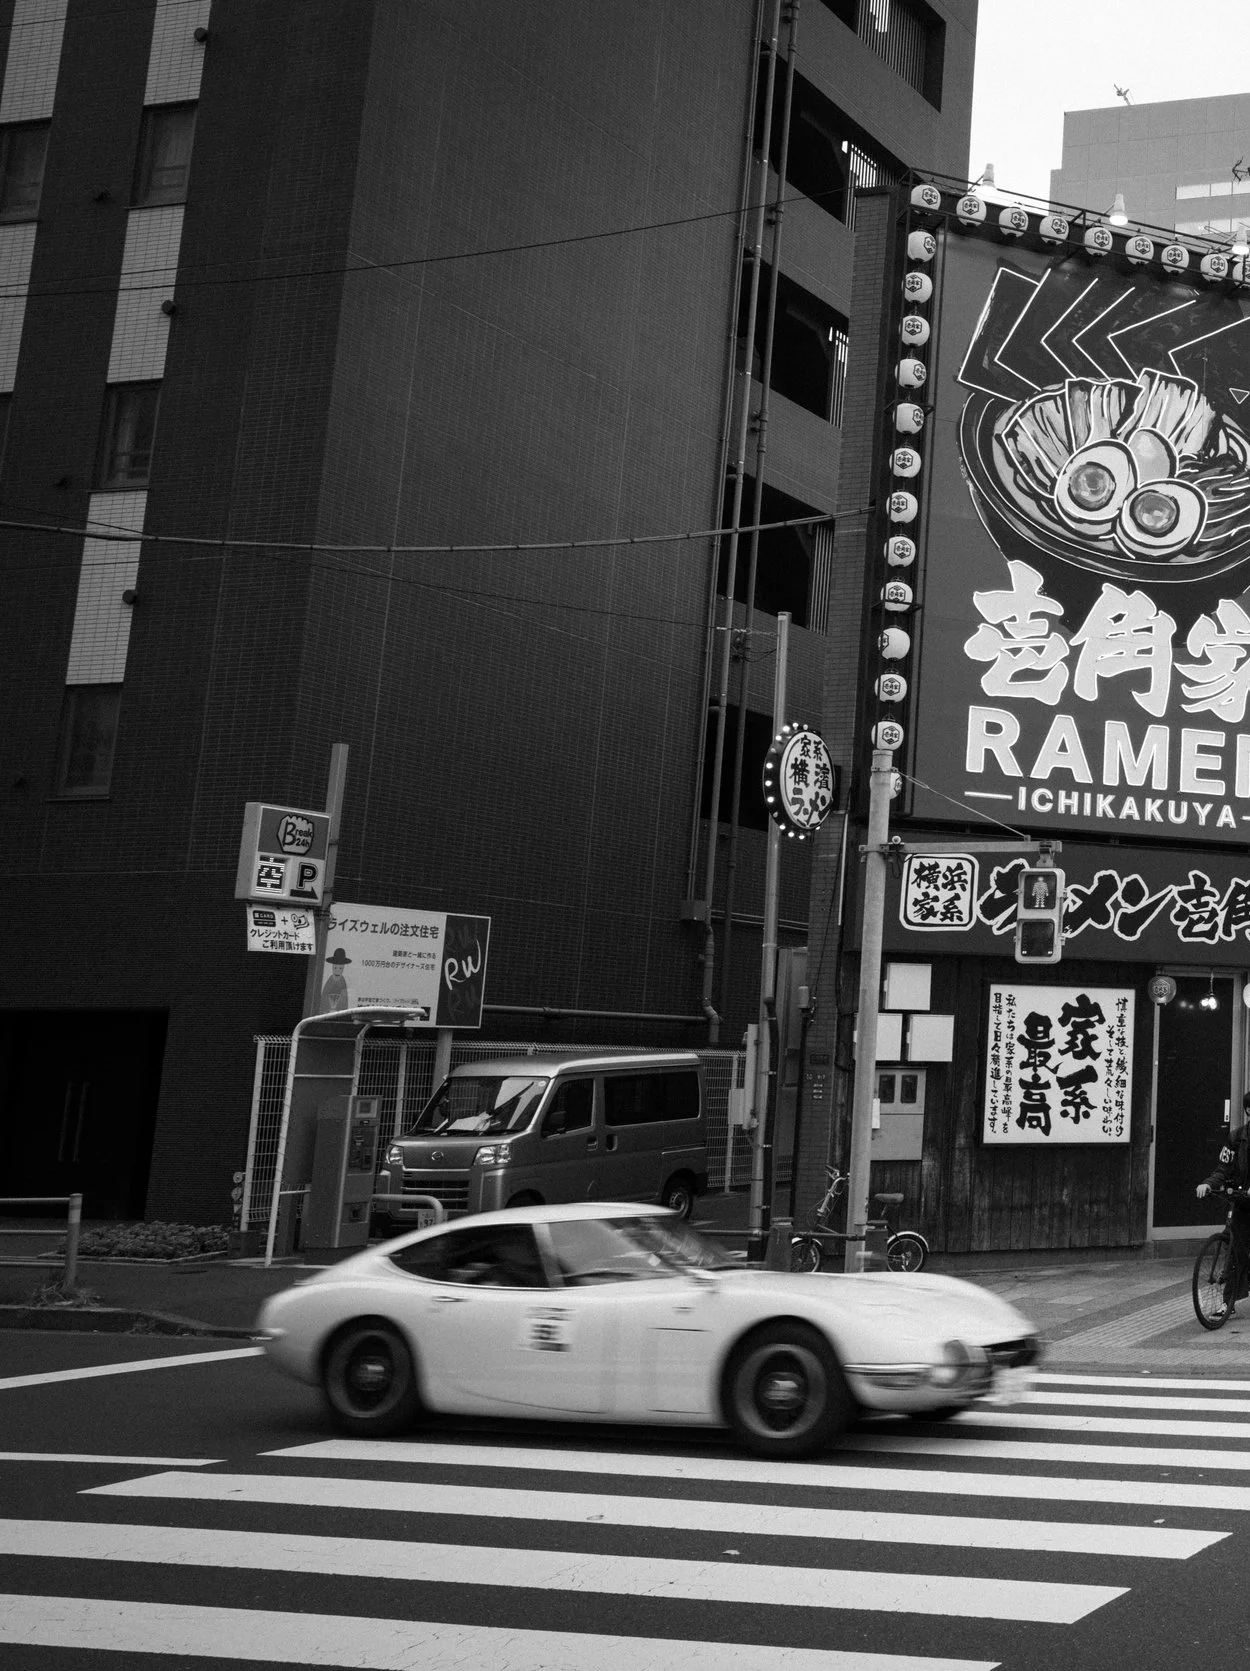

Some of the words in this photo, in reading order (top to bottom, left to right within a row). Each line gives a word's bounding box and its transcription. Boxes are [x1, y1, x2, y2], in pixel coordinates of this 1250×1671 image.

[800, 735, 823, 761] 家系
[1018, 786, 1237, 828] ICHIKAKUYA
[282, 820, 313, 847] Break
[295, 838, 310, 847] 24h
[297, 862, 317, 889] P
[911, 861, 968, 891] 横浜
[912, 891, 964, 922] 家系
[250, 929, 300, 940] クレジットカード
[328, 919, 439, 939] ライズウェルの注文住宅
[262, 940, 314, 951] ご利用頂けます
[1056, 993, 1106, 1125] 家系
[1016, 1011, 1063, 1137] 最高
